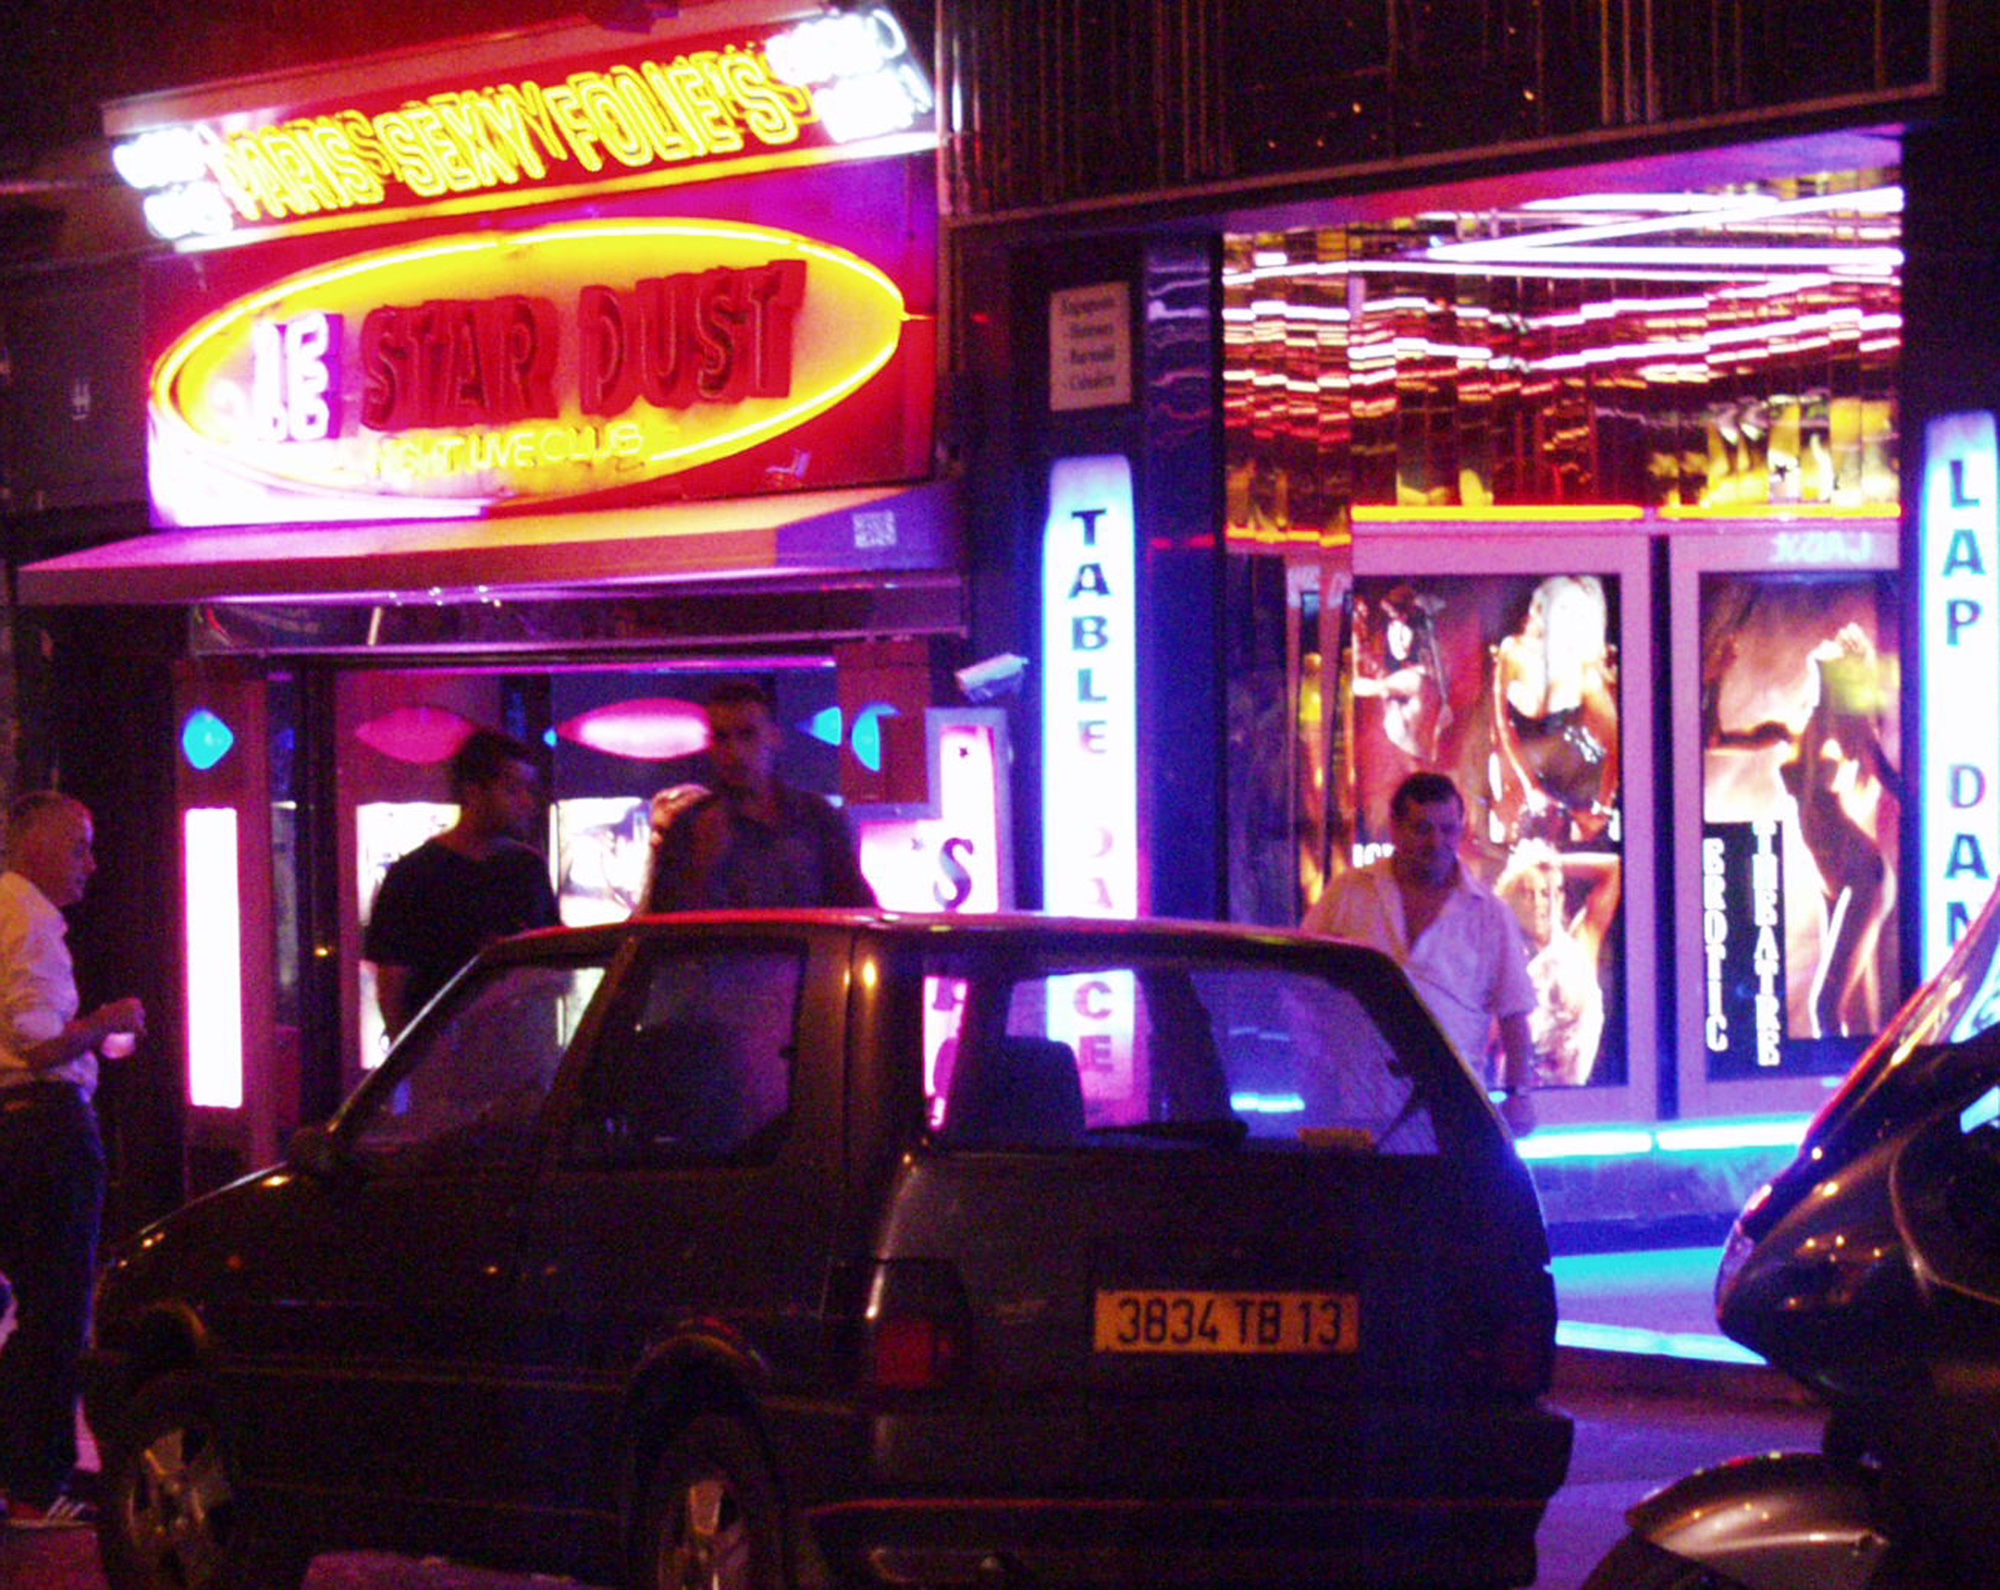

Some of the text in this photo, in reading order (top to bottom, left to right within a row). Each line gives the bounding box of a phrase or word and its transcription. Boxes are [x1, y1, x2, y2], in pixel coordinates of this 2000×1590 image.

[373, 84, 548, 197] SEXY
[361, 297, 558, 432] STAR
[578, 260, 806, 417] DUST
[541, 423, 645, 462] CLUB
[1942, 460, 1985, 647] LAP
[1068, 508, 1112, 754] TABLE
[1117, 1298, 1343, 1346] 3834 TB 13
